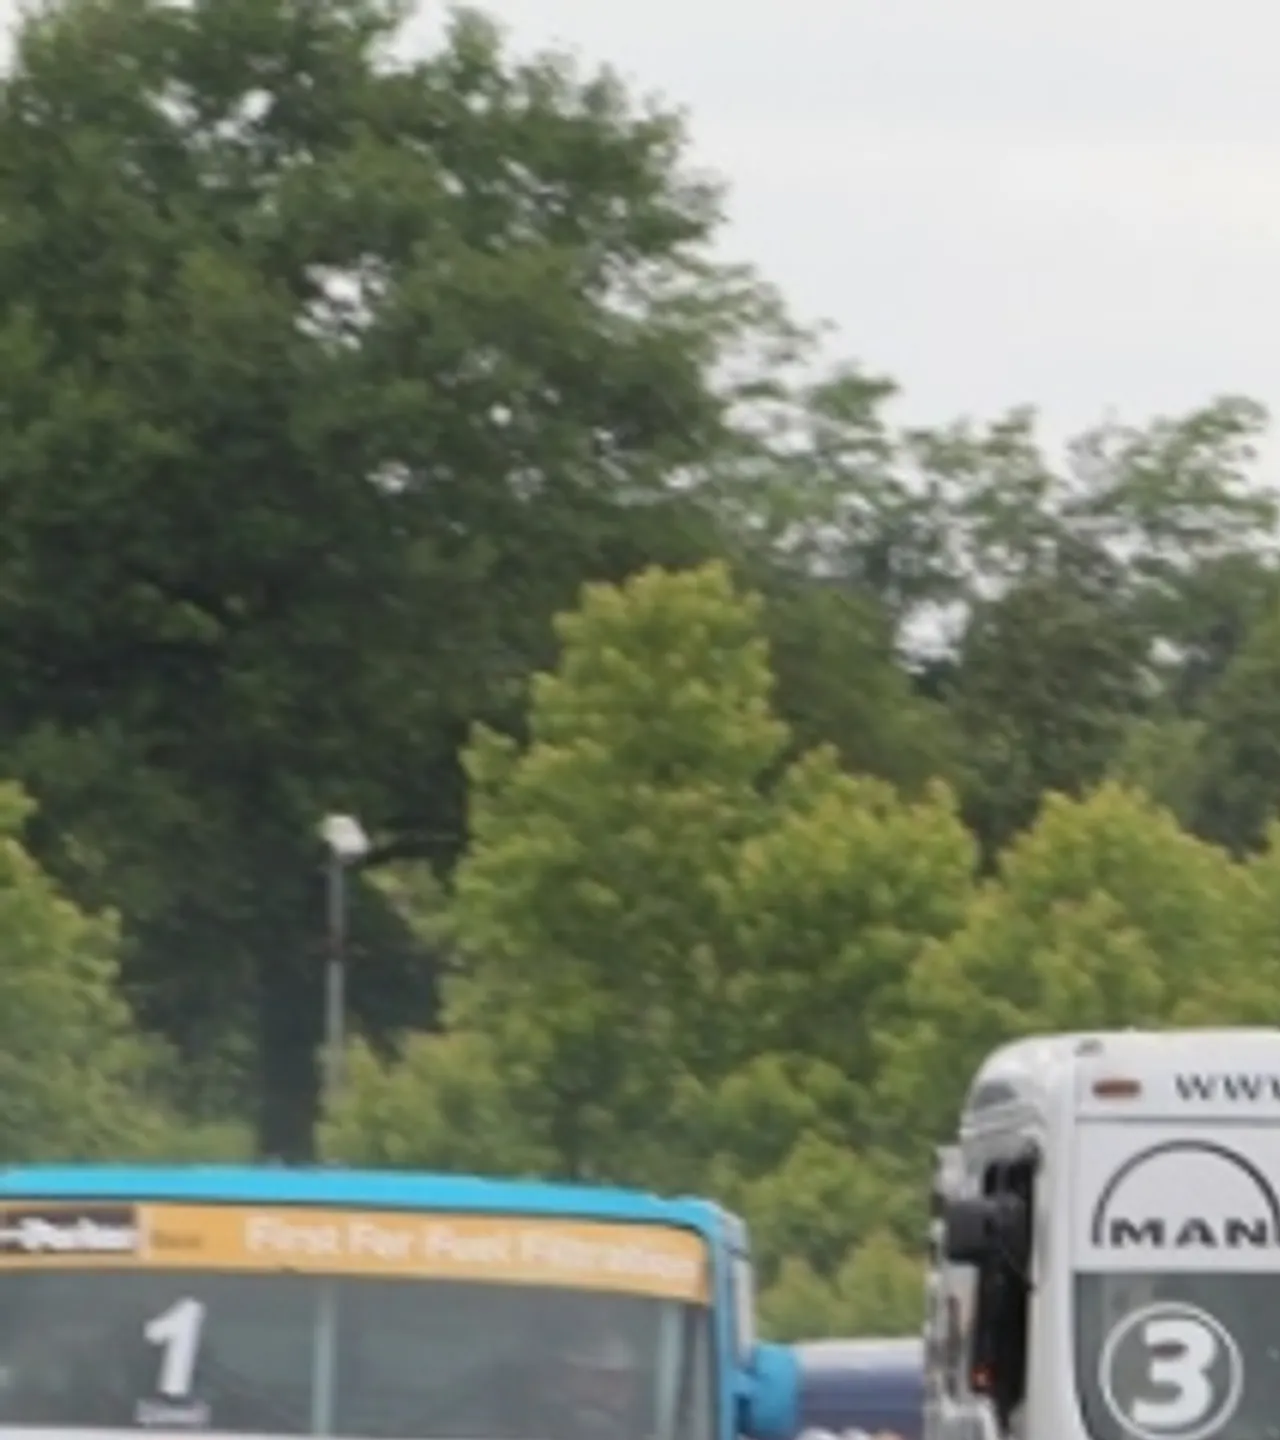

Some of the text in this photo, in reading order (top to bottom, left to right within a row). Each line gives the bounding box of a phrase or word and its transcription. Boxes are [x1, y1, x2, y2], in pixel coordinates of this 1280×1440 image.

[1110, 1217, 1270, 1250] MAN
[143, 1297, 206, 1396] 1
[1130, 1318, 1218, 1428] 3
